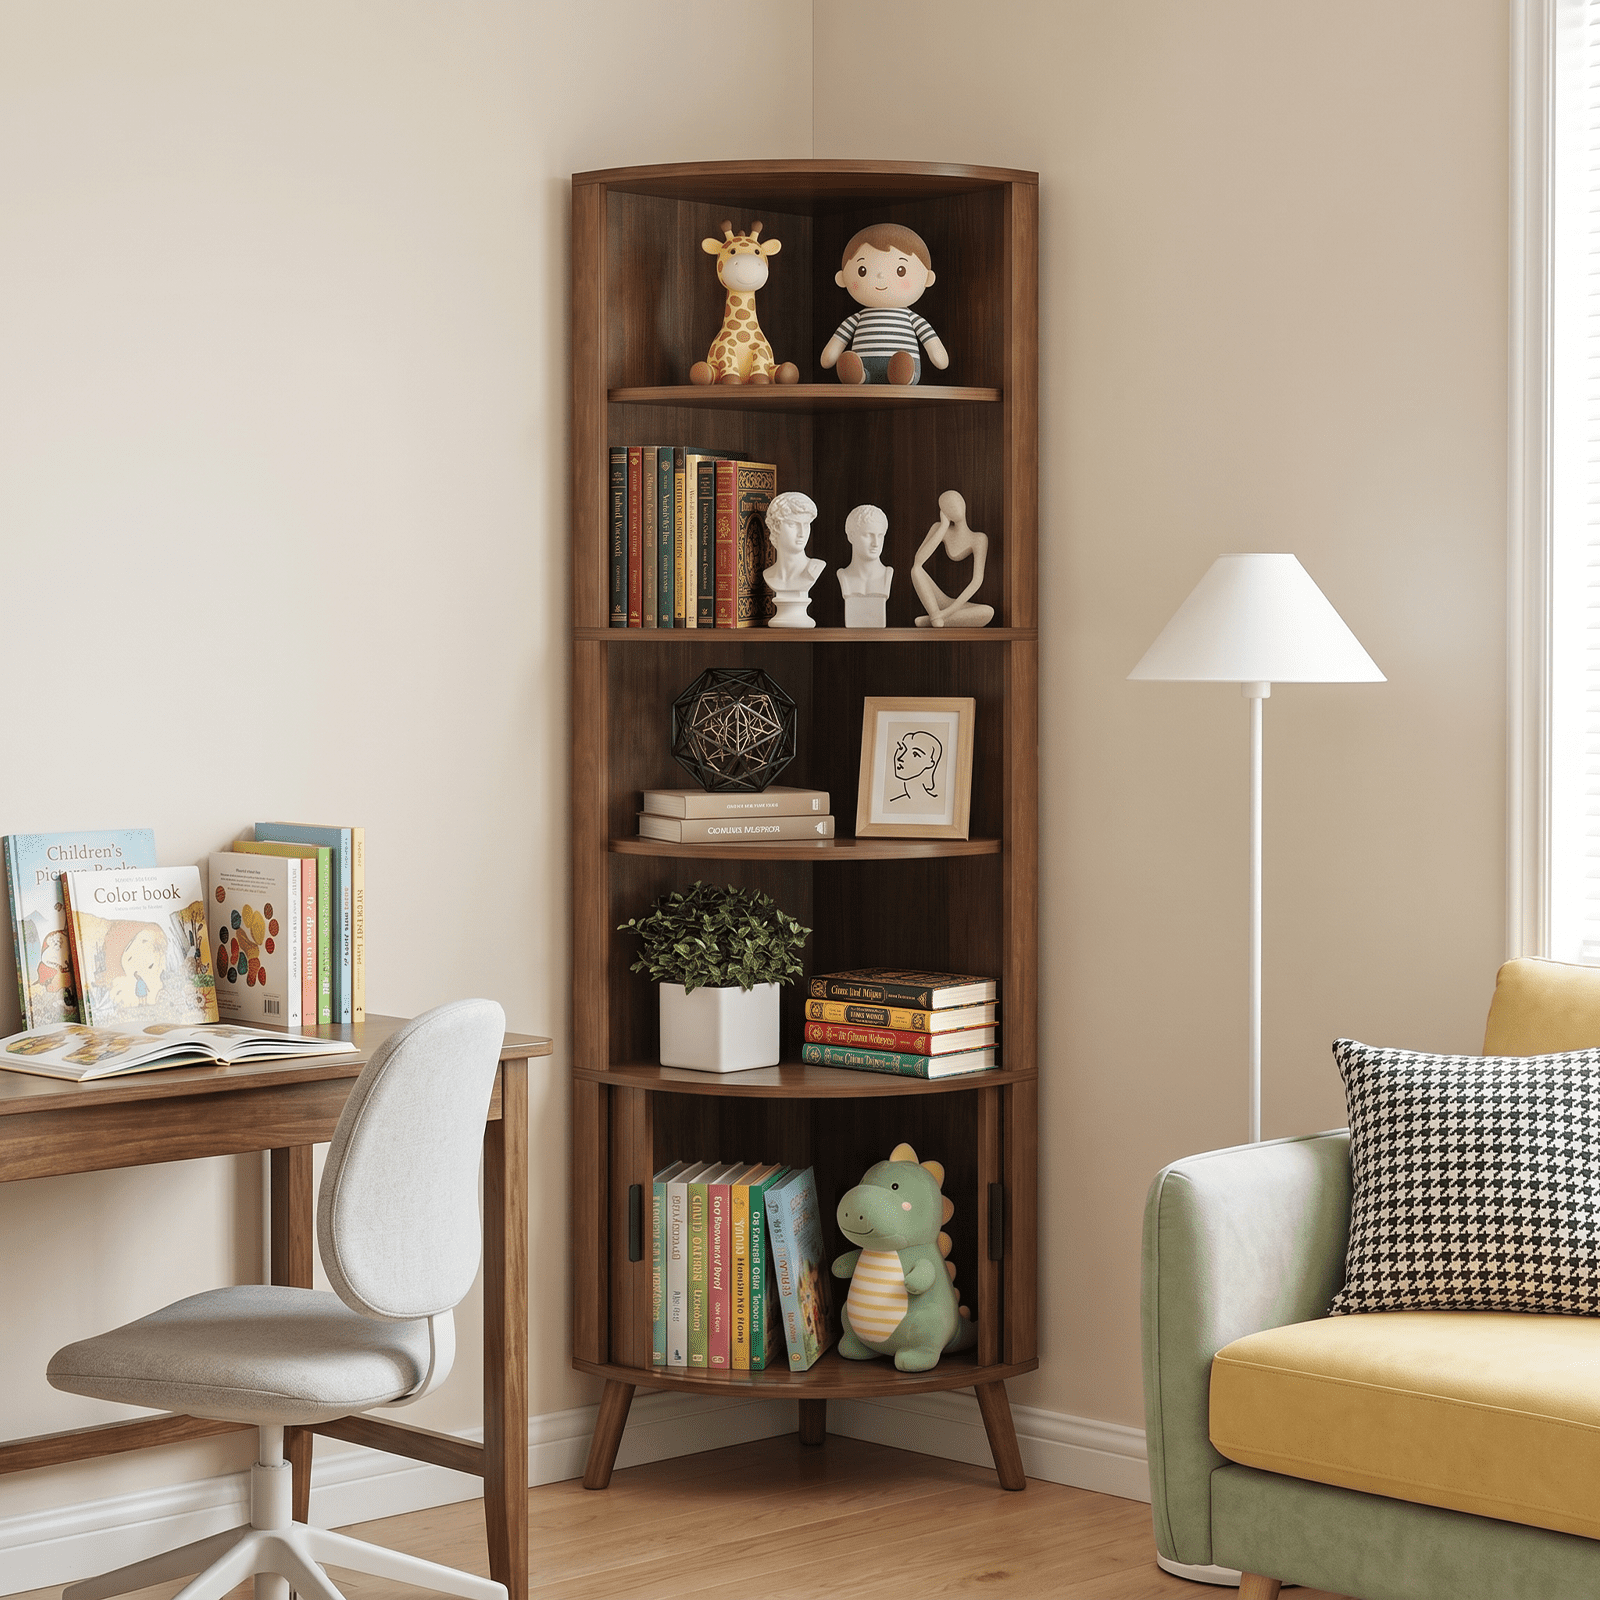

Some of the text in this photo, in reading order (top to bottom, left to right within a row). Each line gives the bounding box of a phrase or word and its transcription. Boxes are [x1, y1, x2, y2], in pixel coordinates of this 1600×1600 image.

[47, 843, 122, 861] Children's
[94, 883, 181, 904] Color book
